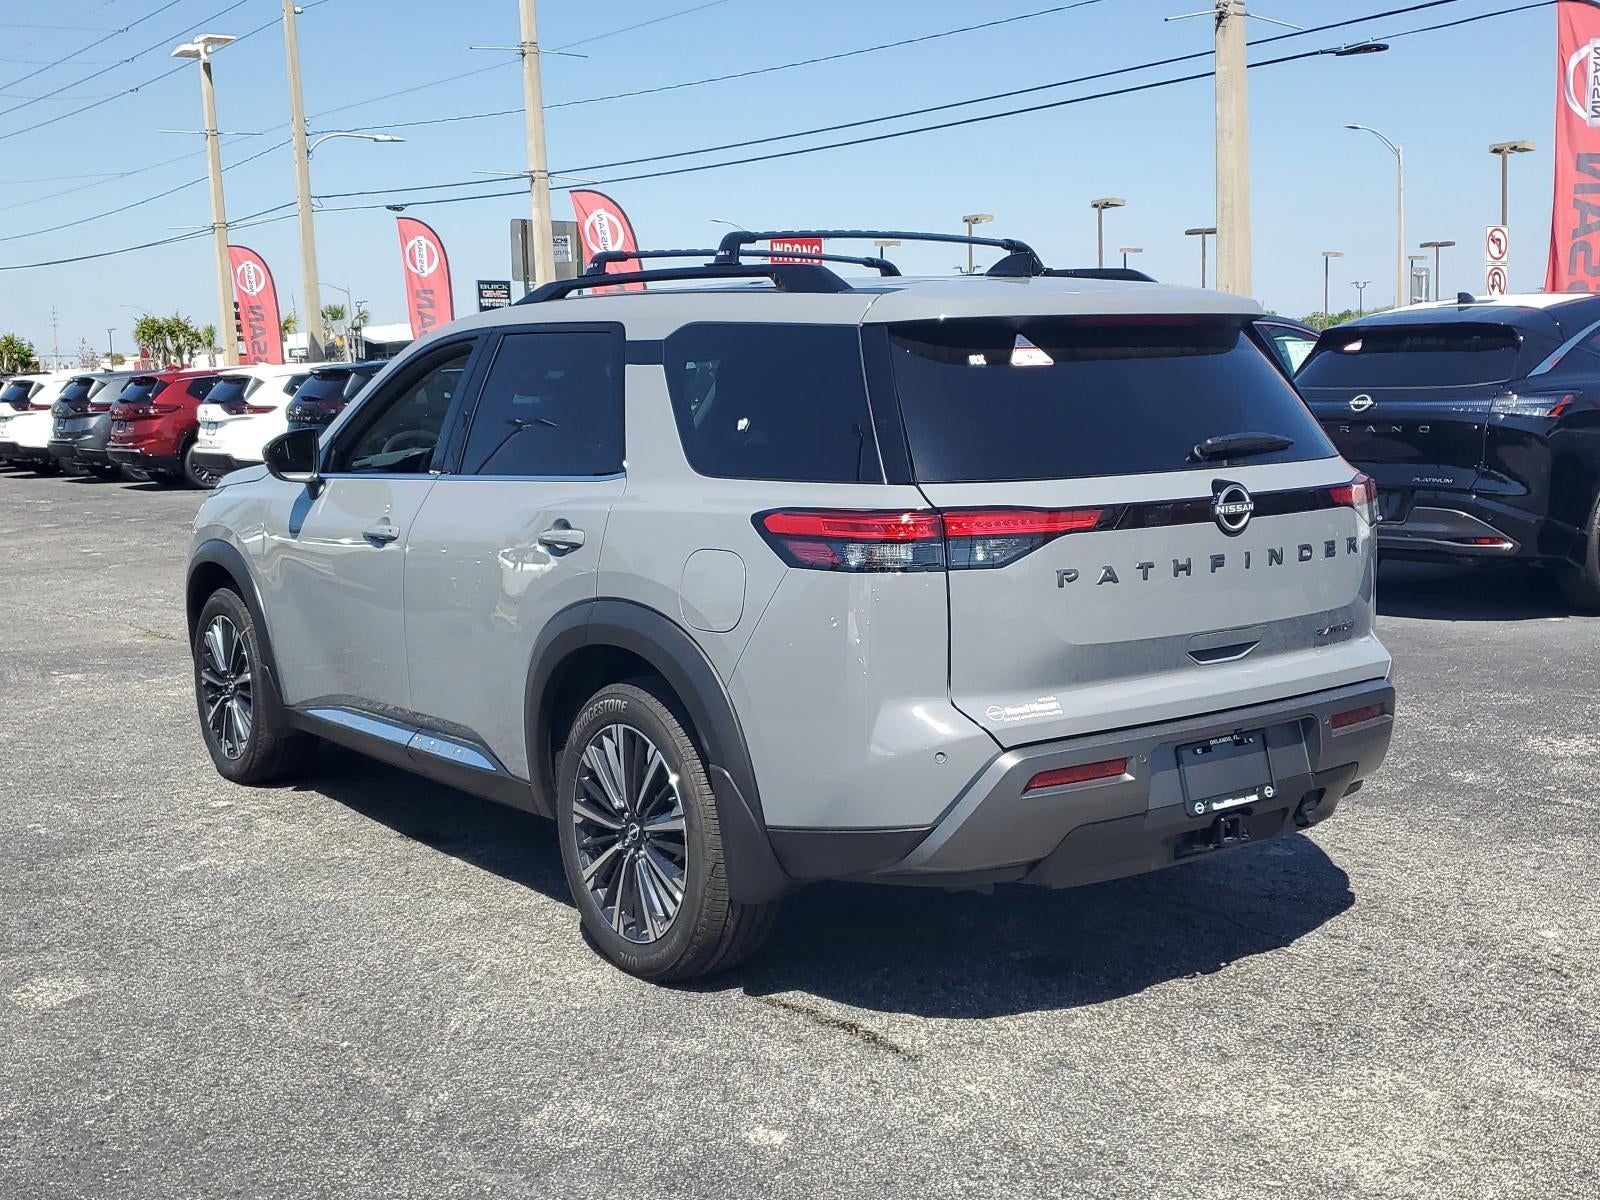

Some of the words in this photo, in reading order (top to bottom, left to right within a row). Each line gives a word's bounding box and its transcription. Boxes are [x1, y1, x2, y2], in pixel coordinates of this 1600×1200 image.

[772, 242, 821, 263] WRONG
[482, 290, 508, 298] GMC
[1216, 503, 1254, 515] NISSAN
[1055, 535, 1359, 589] PATHFINDER
[572, 698, 629, 745] BRIDGESTONE
